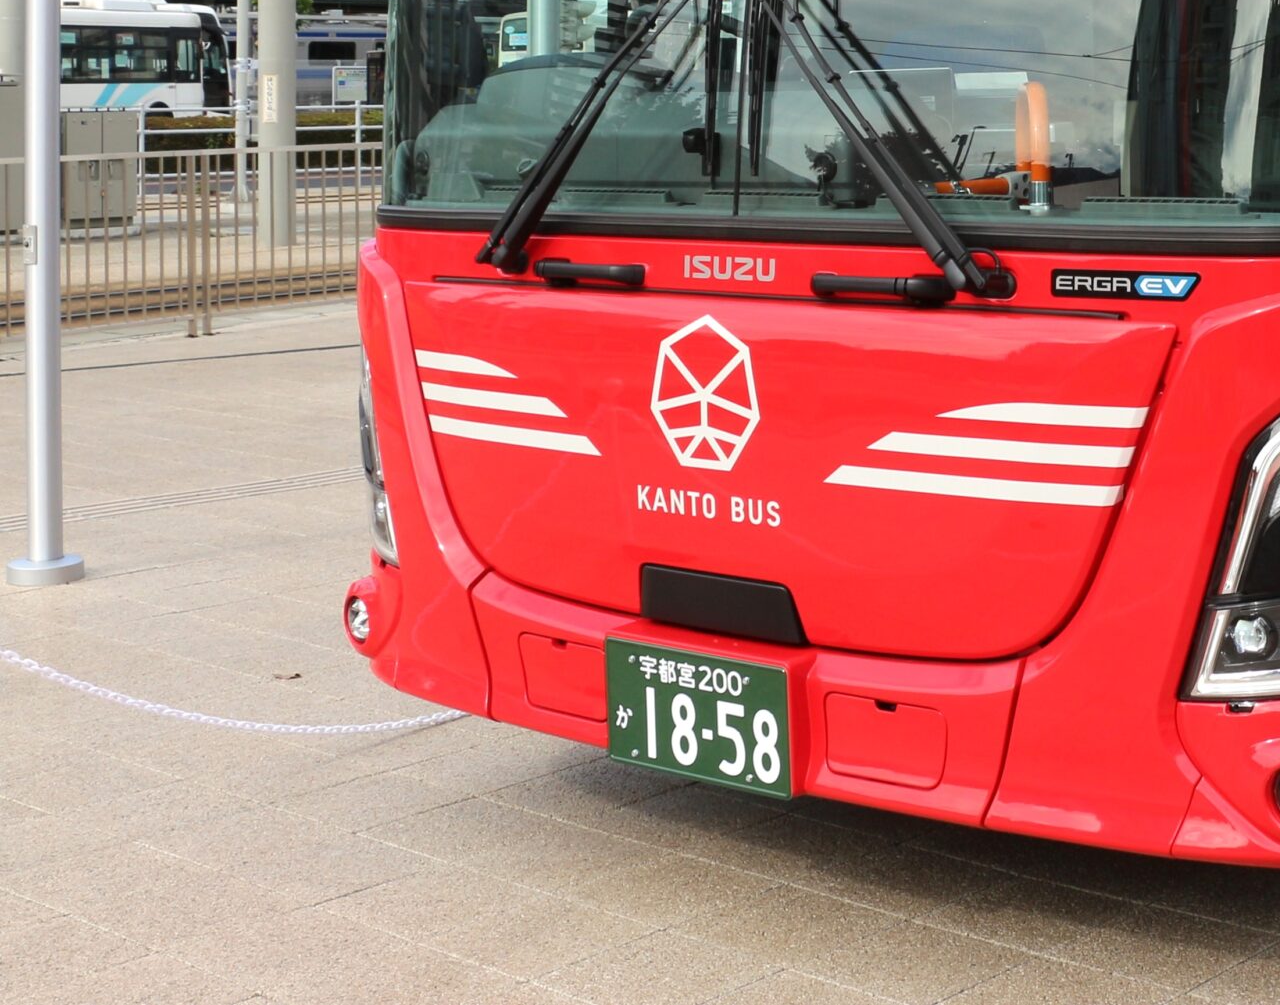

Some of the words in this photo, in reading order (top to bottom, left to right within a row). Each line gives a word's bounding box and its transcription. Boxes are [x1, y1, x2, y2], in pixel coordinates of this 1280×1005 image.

[684, 255, 777, 283] ISUZU
[1055, 275, 1131, 293] ERGA
[1139, 277, 1189, 295] EV
[637, 484, 716, 521] KANTO
[730, 496, 782, 528] BUS
[615, 704, 634, 730] か
[645, 686, 781, 785] 18-58
